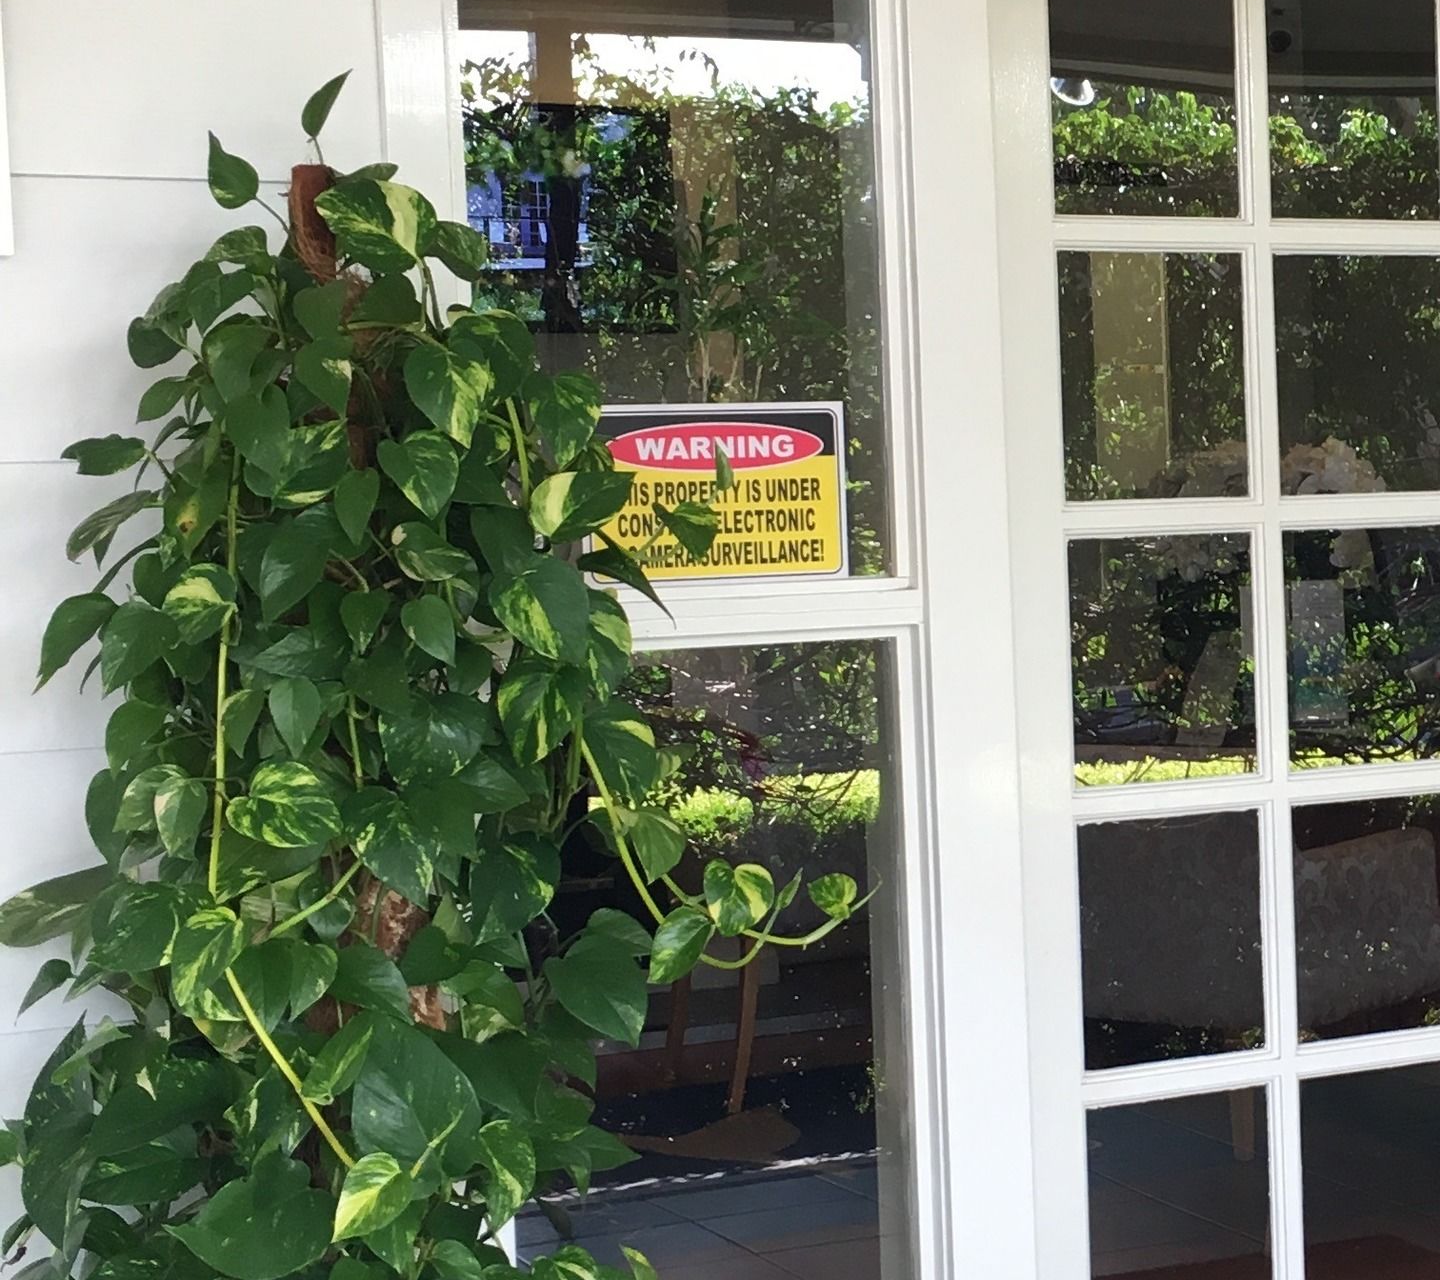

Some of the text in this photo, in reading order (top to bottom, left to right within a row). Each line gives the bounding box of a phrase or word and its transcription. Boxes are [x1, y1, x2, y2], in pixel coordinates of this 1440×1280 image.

[635, 435, 794, 460] WARNING
[746, 479, 761, 503] IS
[766, 477, 821, 502] UNDER
[629, 545, 697, 569] AMERA
